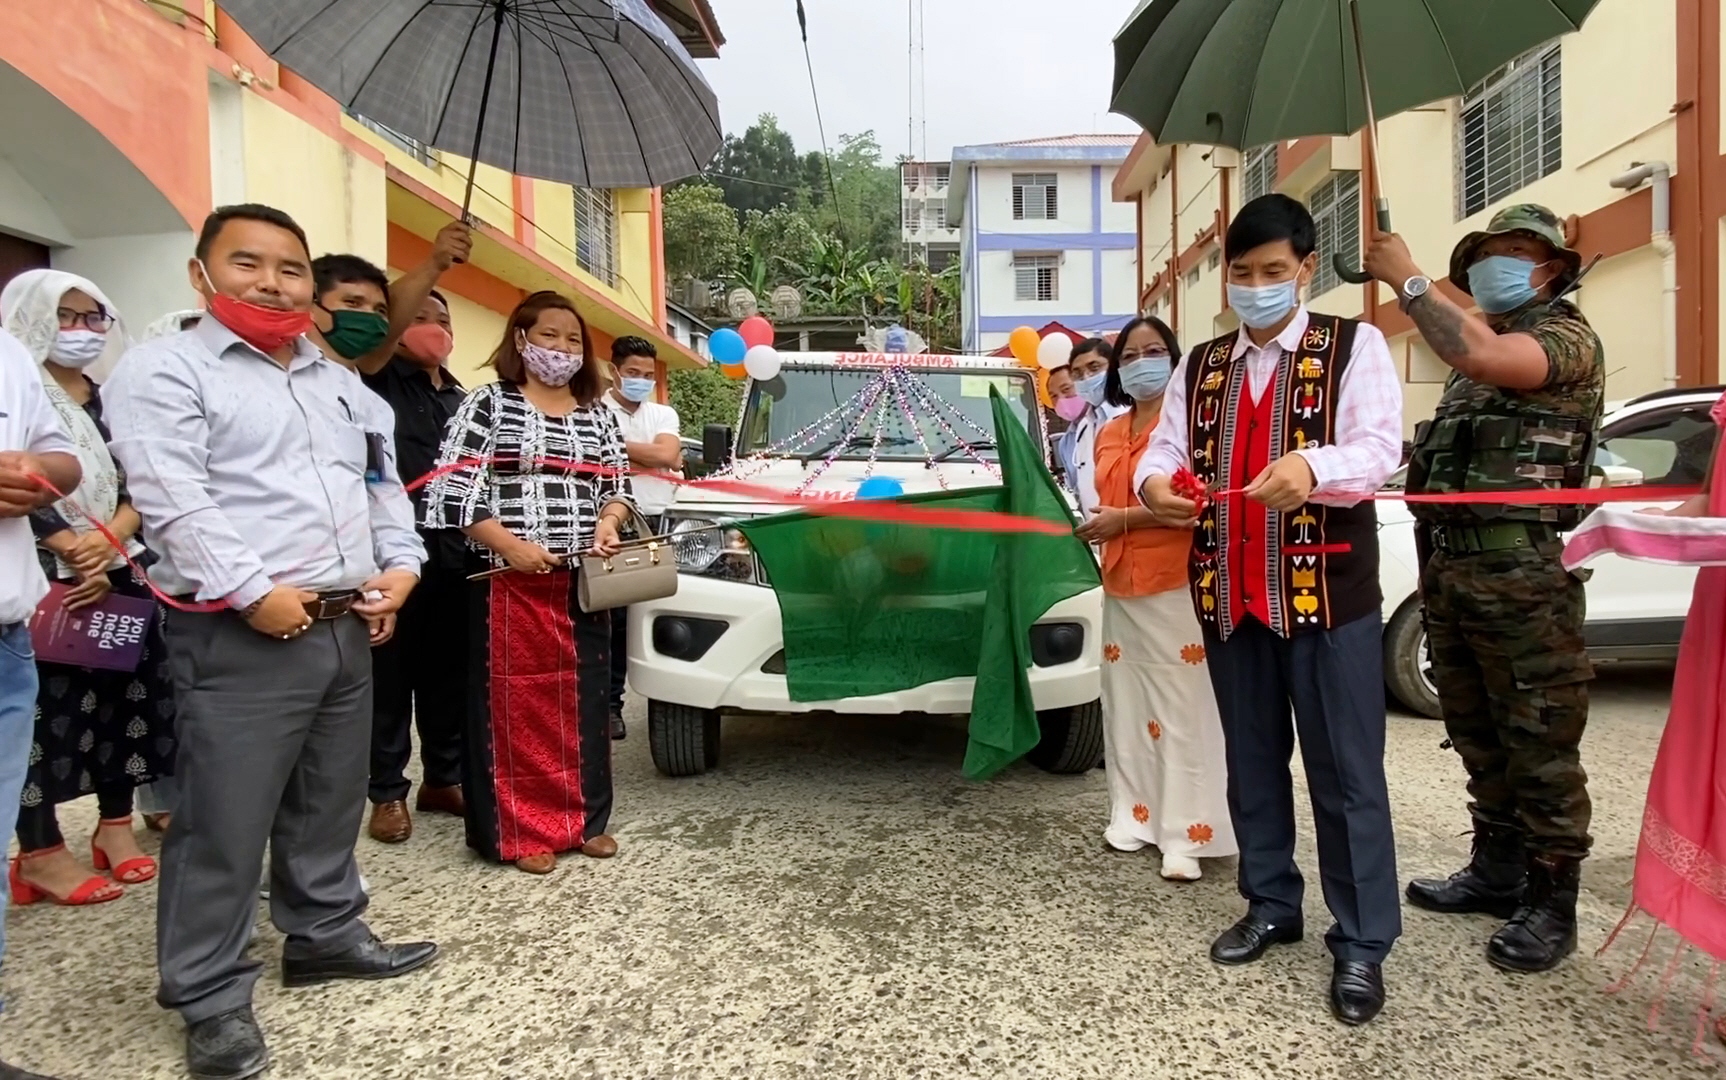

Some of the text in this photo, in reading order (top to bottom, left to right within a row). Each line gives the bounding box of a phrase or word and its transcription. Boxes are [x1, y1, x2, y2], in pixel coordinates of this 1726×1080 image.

[87, 611, 105, 638] one
[98, 614, 118, 649] need
[113, 615, 131, 646] only
[129, 616, 145, 643] you
